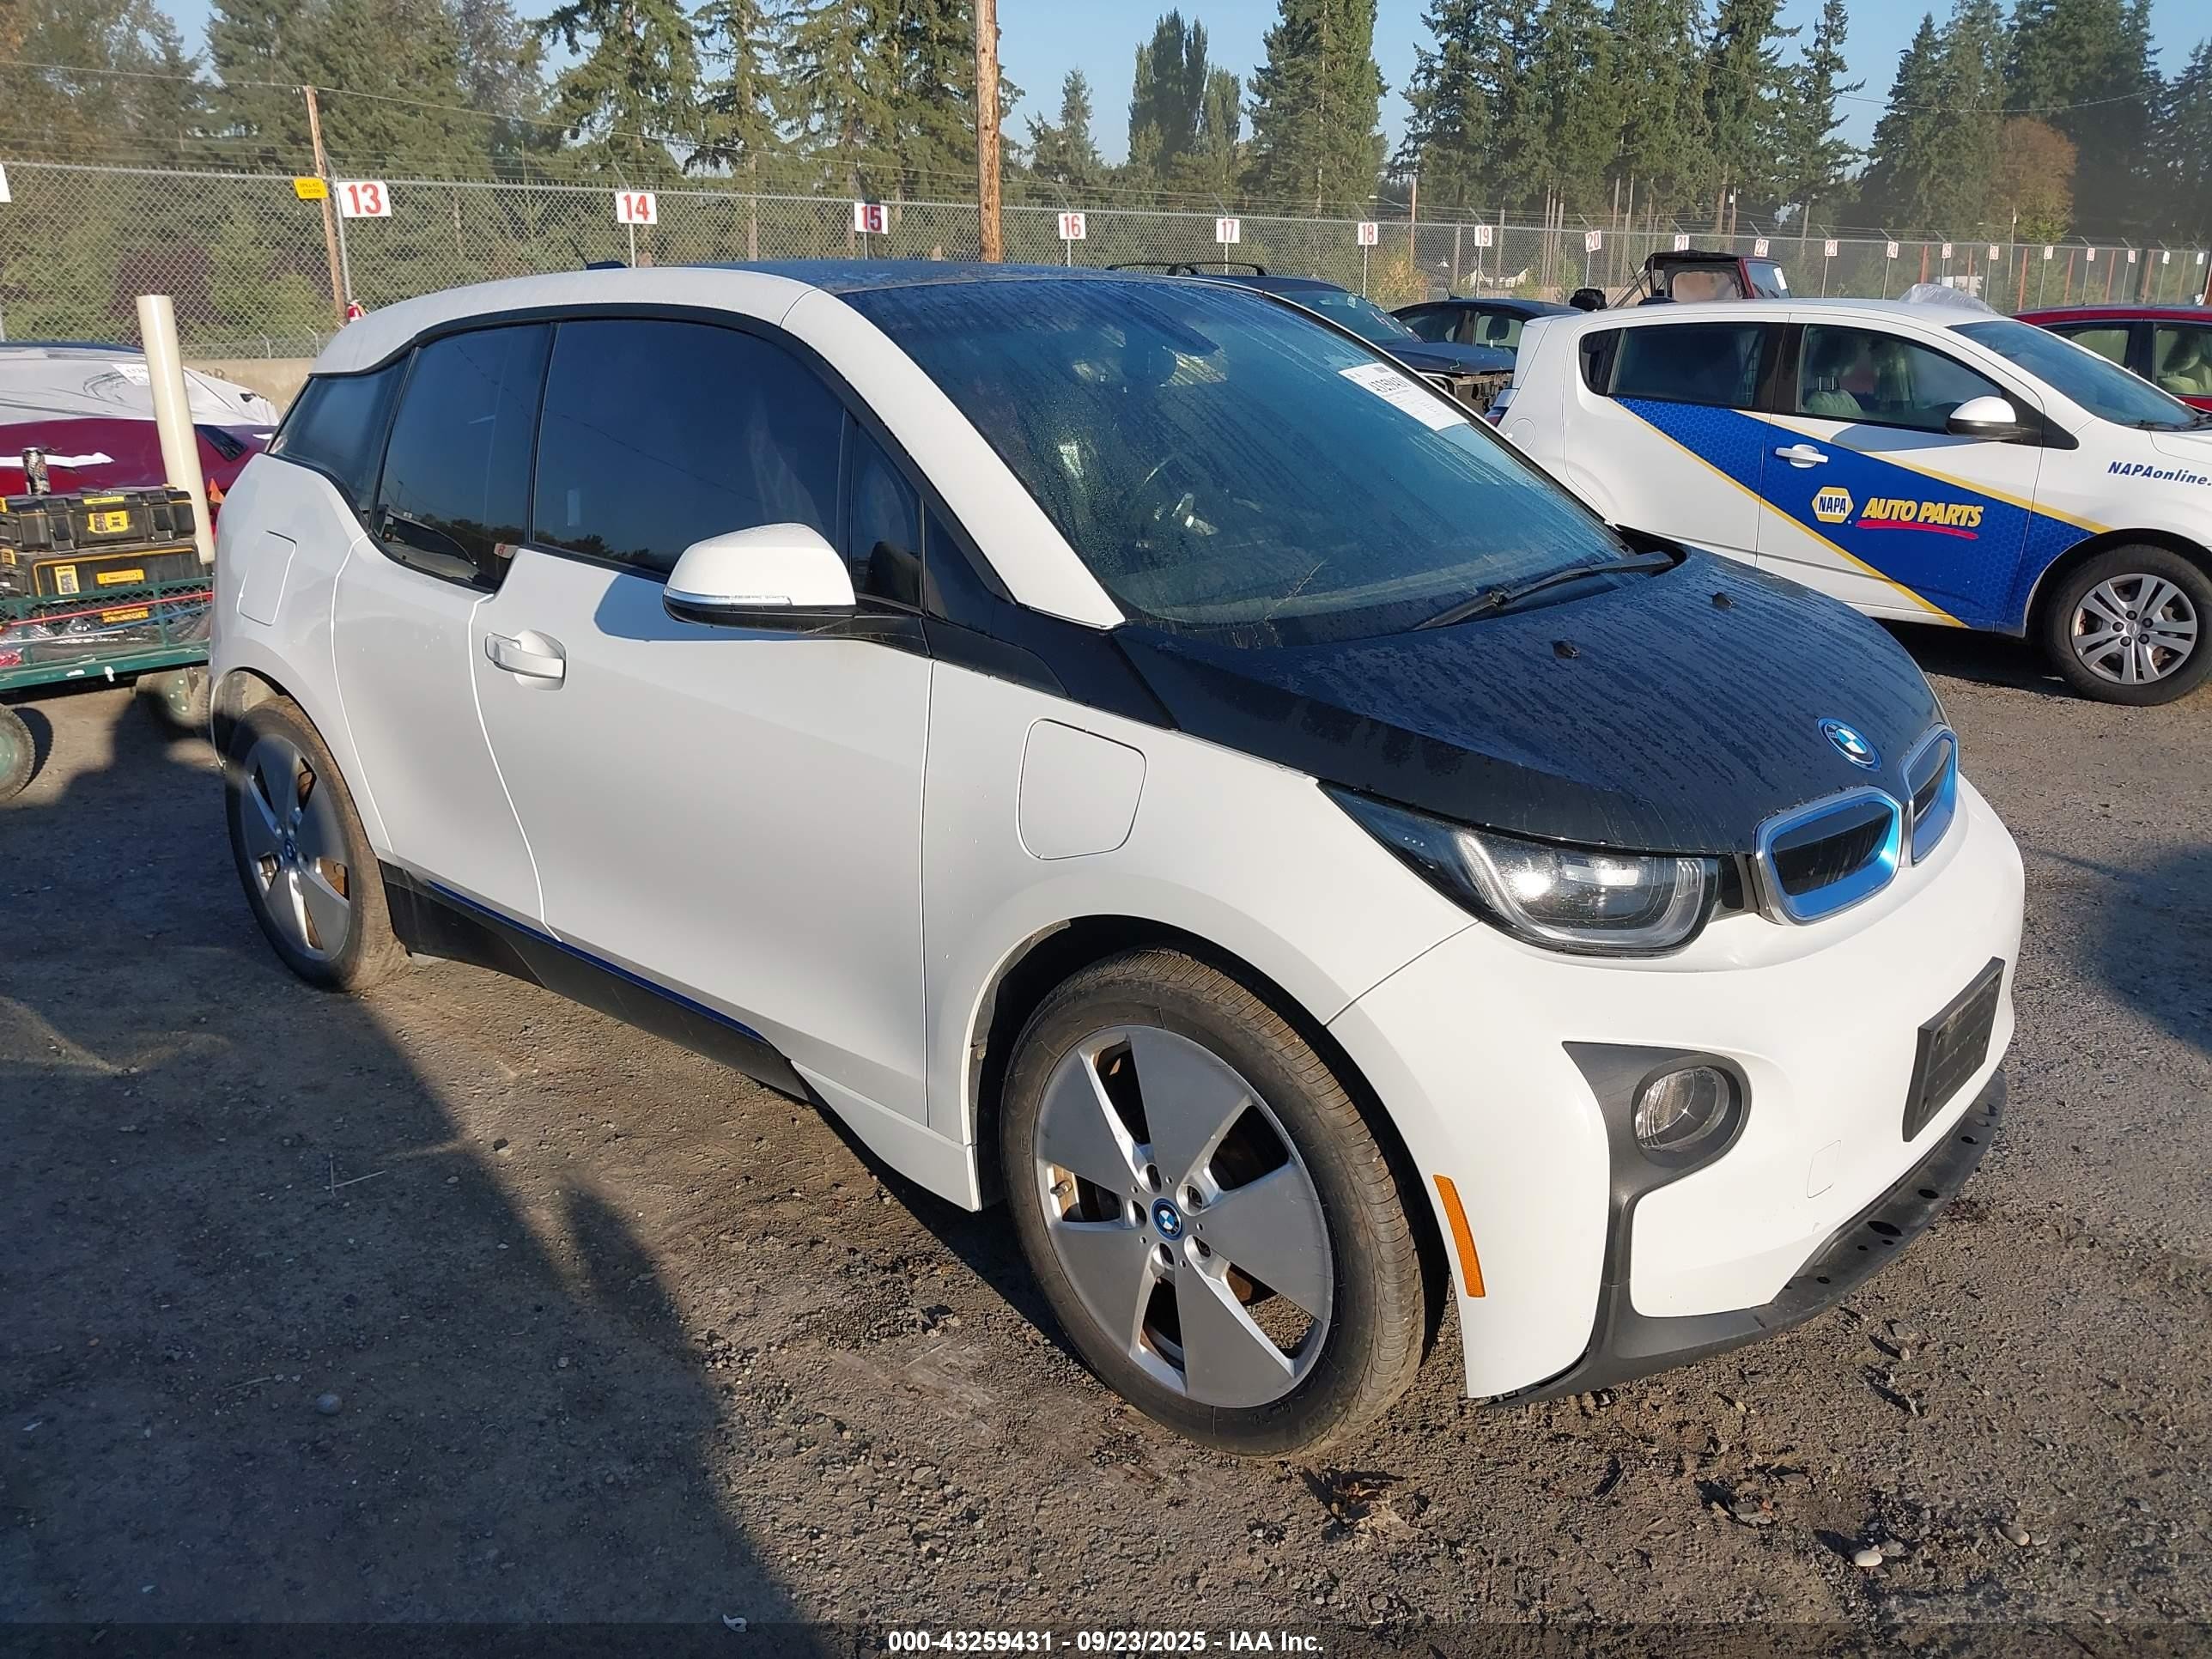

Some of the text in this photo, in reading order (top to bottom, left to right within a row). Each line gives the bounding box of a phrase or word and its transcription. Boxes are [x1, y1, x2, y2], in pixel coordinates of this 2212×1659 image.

[348, 183, 381, 215] 13
[623, 194, 650, 221] 14
[860, 205, 882, 232] 15
[1063, 215, 1081, 237] 16
[1221, 220, 1235, 241] 17
[1361, 224, 1375, 243] 18
[1479, 227, 1490, 245] 19
[1587, 232, 1600, 249] 20
[1677, 236, 1686, 250] 21
[1756, 240, 1767, 255] 22
[1826, 240, 1836, 255] 23
[1888, 242, 1897, 257] 24
[2107, 460, 2212, 487] NAPAonline.
[1818, 495, 1846, 514] NAPA
[1861, 497, 1984, 527] AUTO PARTS
